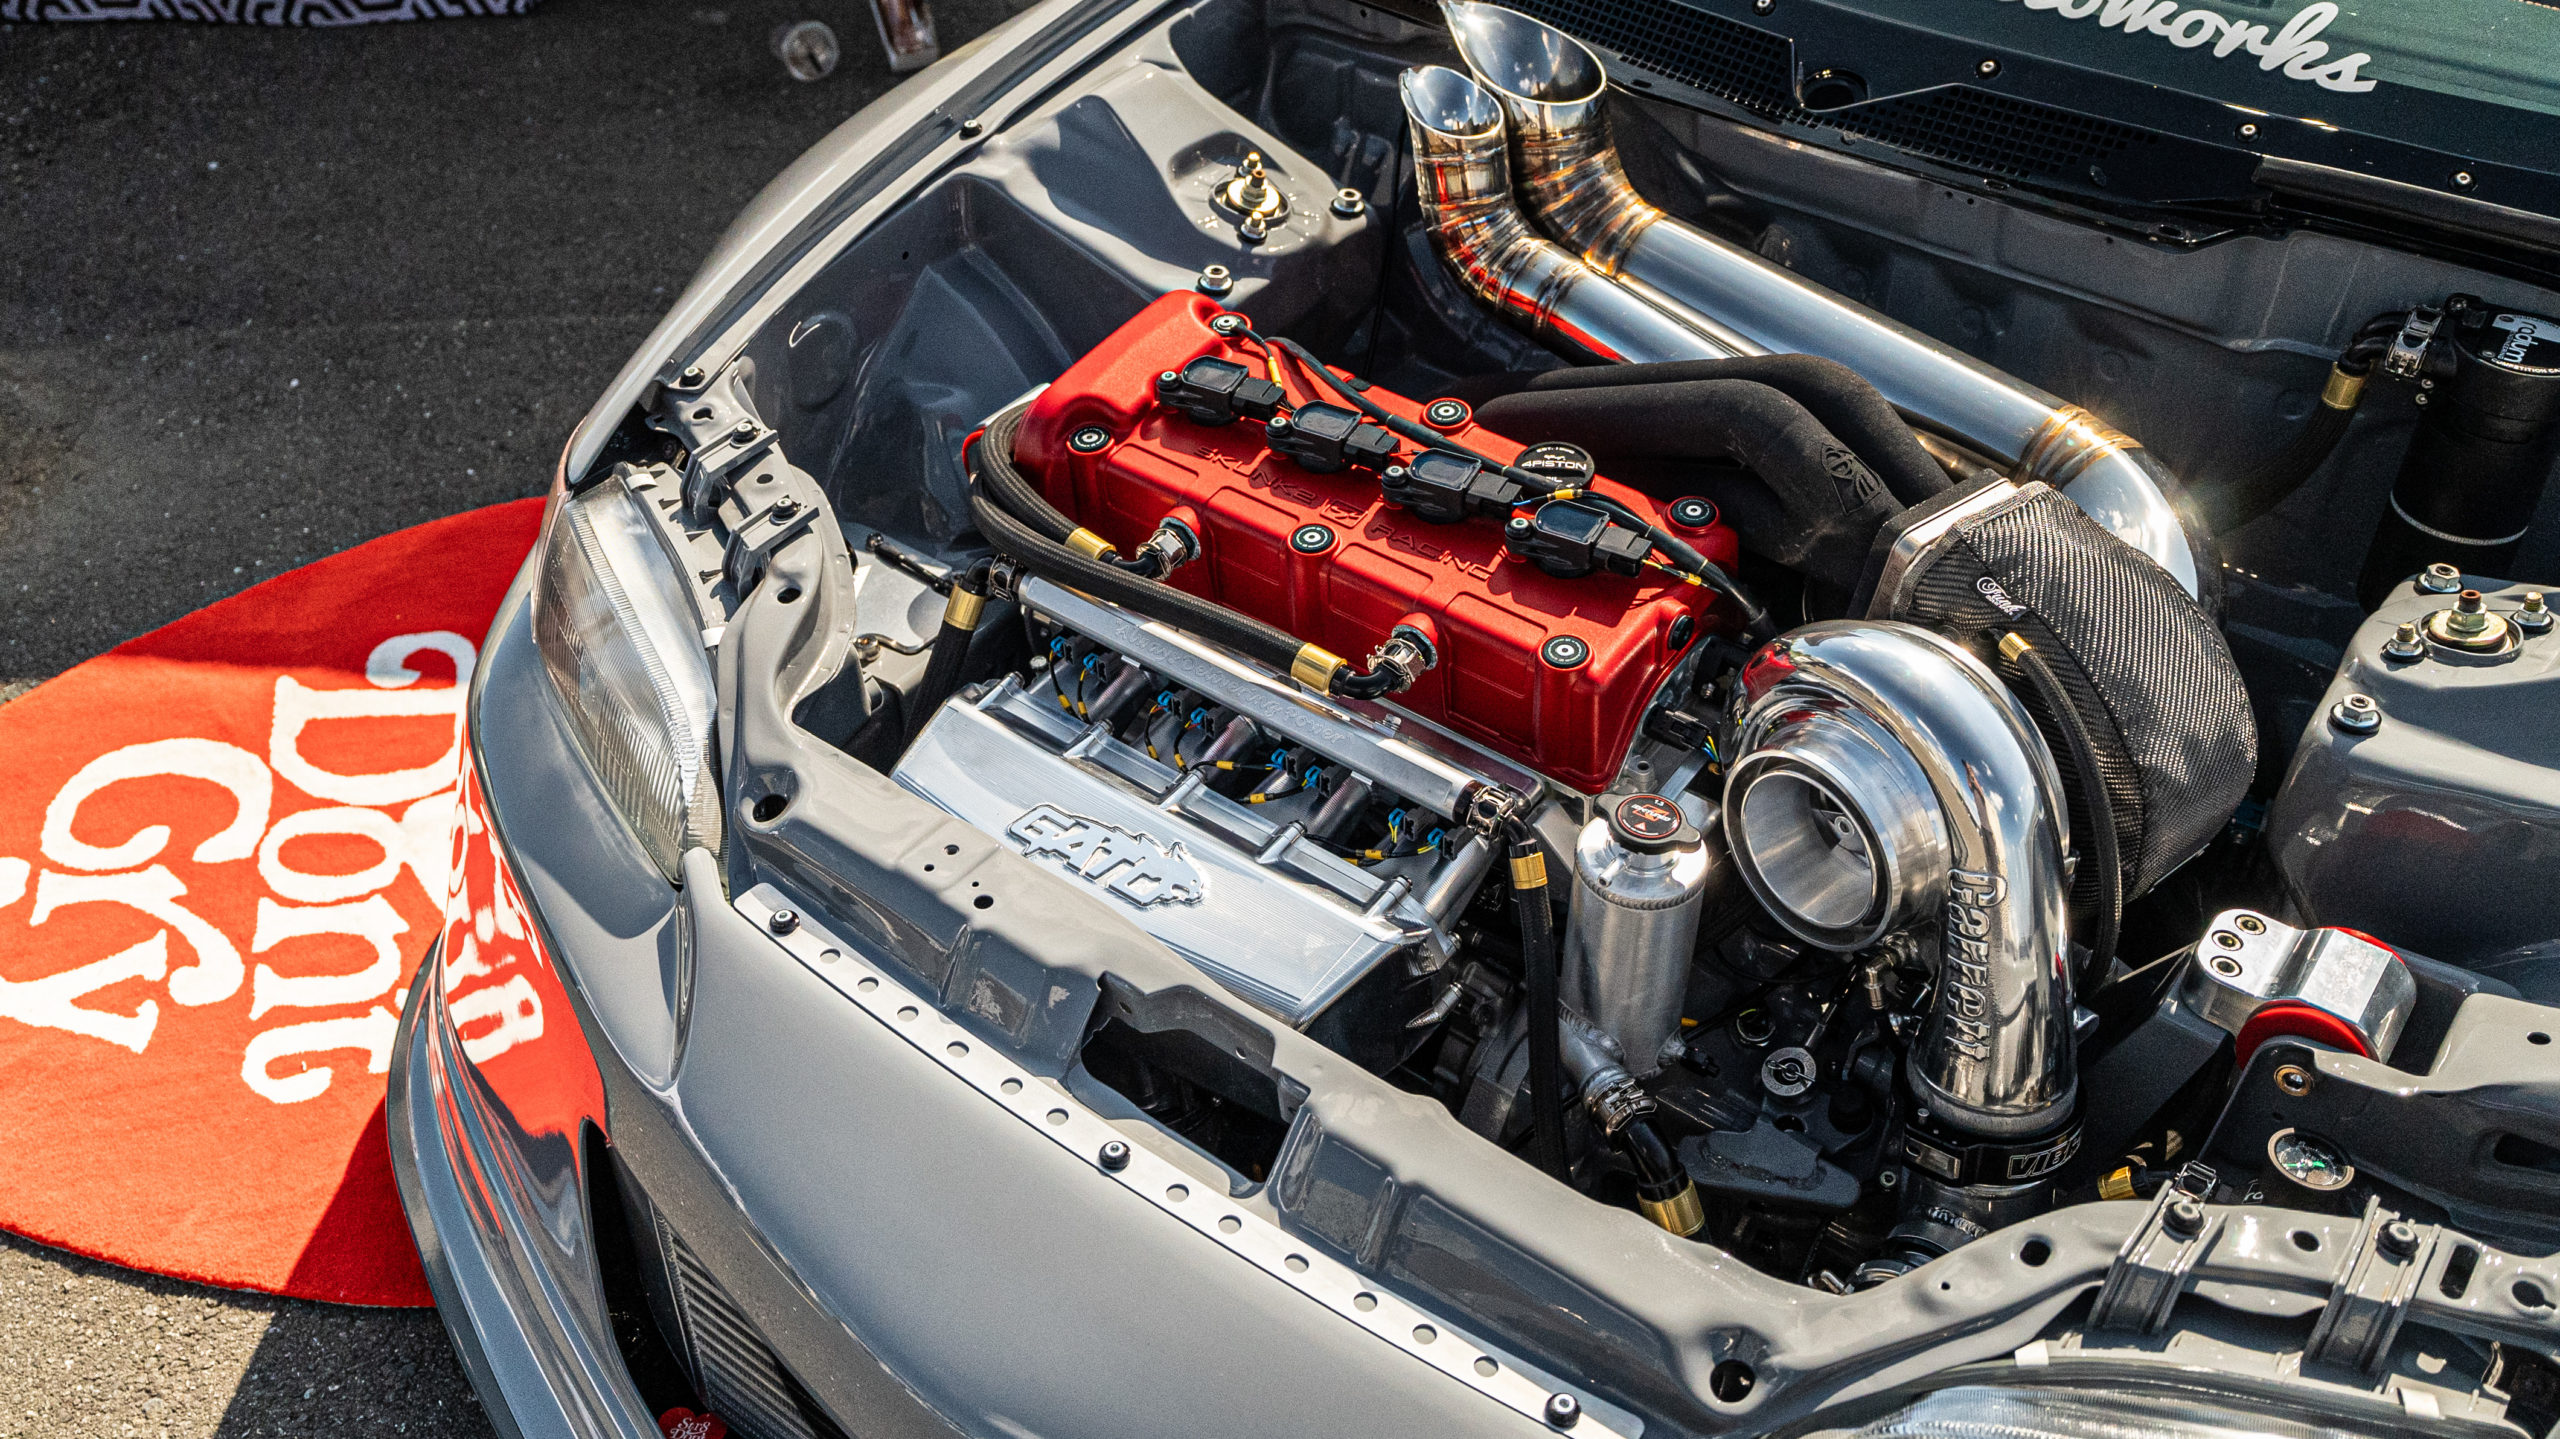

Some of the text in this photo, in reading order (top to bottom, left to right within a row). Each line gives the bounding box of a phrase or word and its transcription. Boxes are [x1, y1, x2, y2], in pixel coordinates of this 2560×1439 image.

[1521, 460, 1587, 471] 4PISTON
[1370, 523, 1493, 582] RACING
[0, 737, 273, 1055] Cry
[1946, 868, 2008, 1061] Garrett
